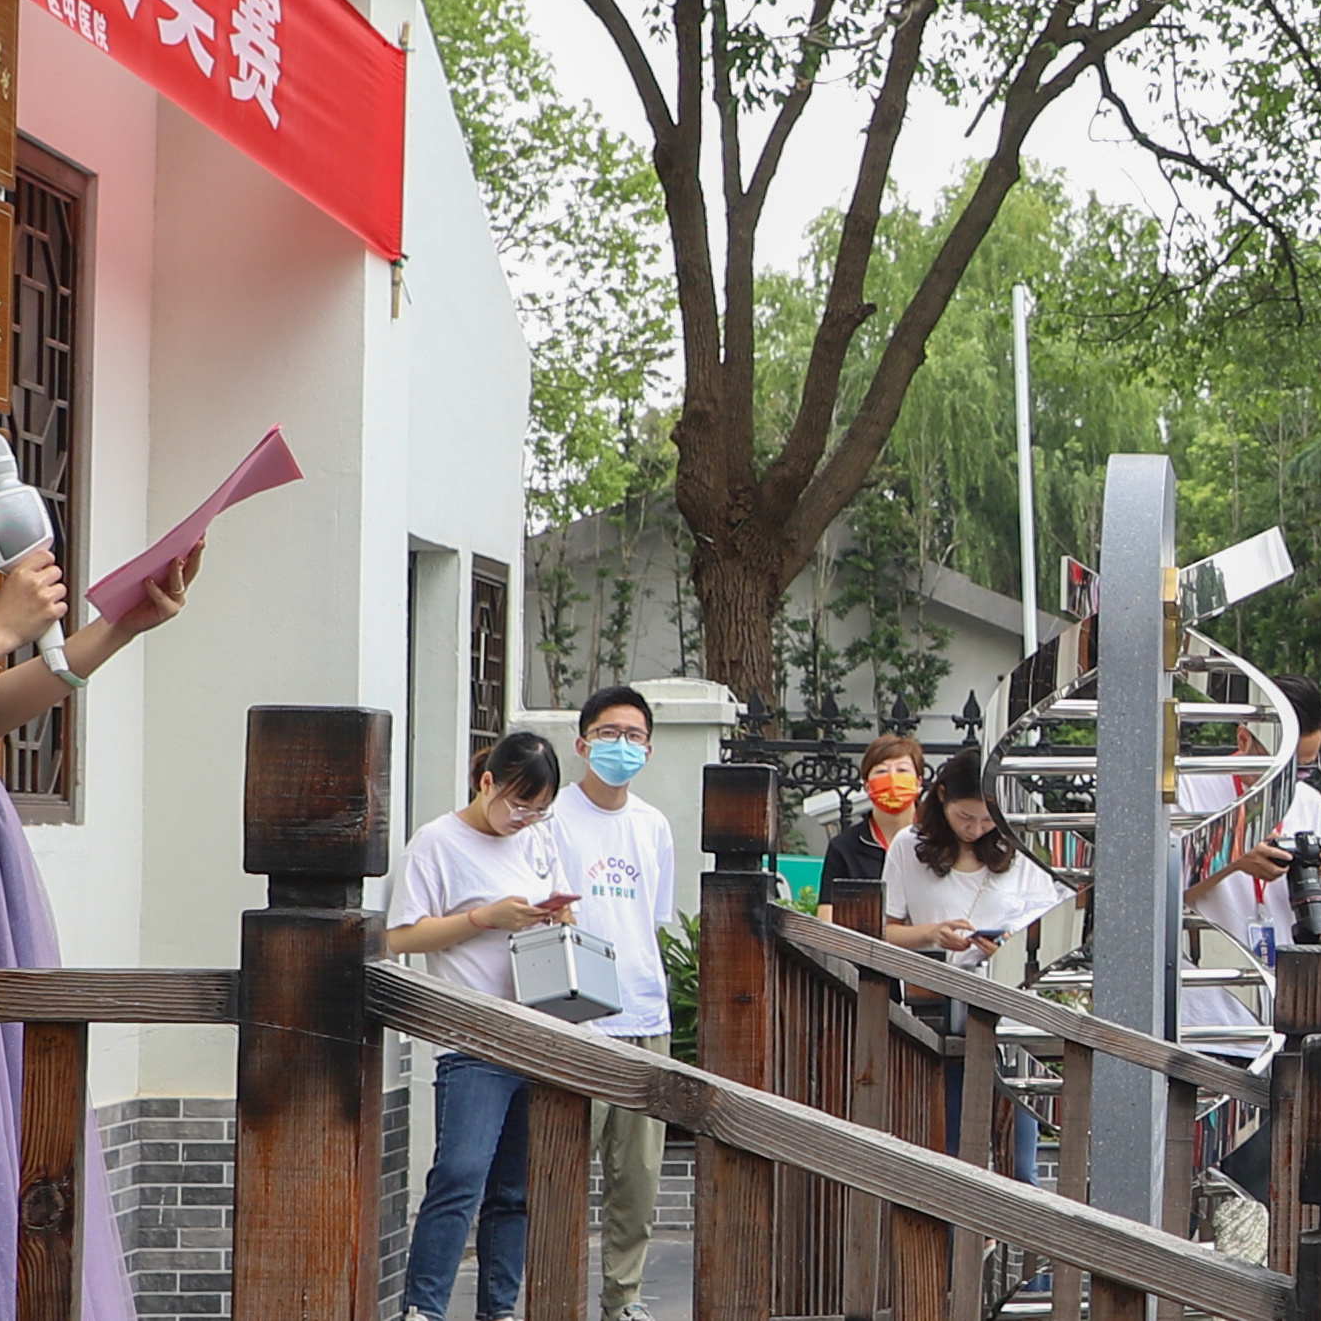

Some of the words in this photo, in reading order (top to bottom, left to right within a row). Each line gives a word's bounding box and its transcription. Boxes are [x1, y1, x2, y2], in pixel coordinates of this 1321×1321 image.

[606, 857, 641, 883] COOL
[606, 873, 622, 884] TO
[592, 885, 605, 897] BE
[609, 886, 636, 899] TRUE
